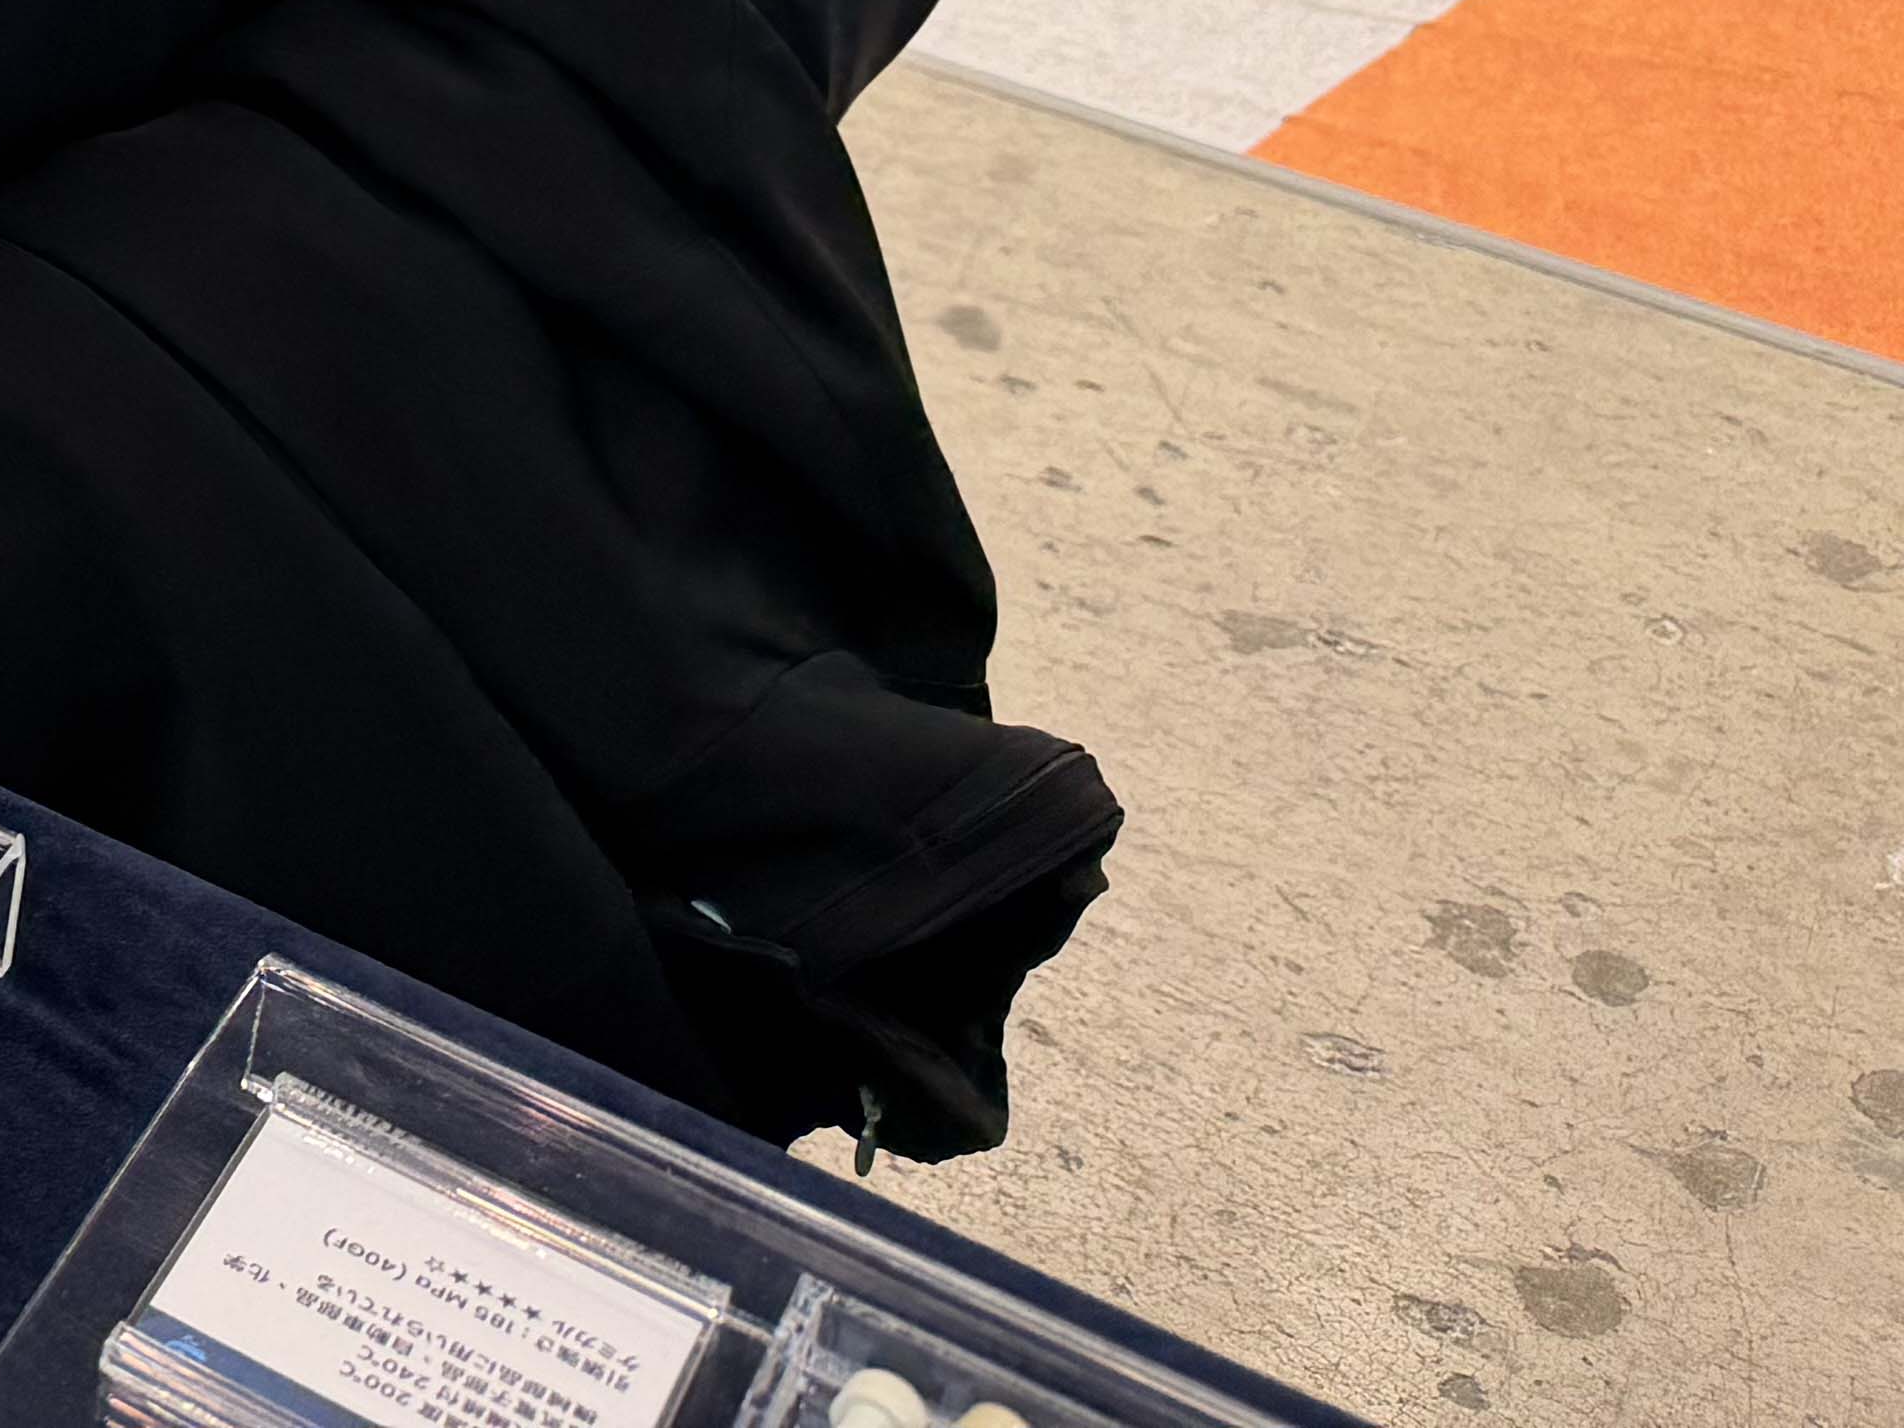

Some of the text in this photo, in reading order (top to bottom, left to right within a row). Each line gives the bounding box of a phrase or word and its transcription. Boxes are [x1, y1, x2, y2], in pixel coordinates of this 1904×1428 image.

[323, 1228, 407, 1281] (40GF)
[415, 1274, 468, 1310] MPa
[552, 1320, 639, 1372] ケミカル
